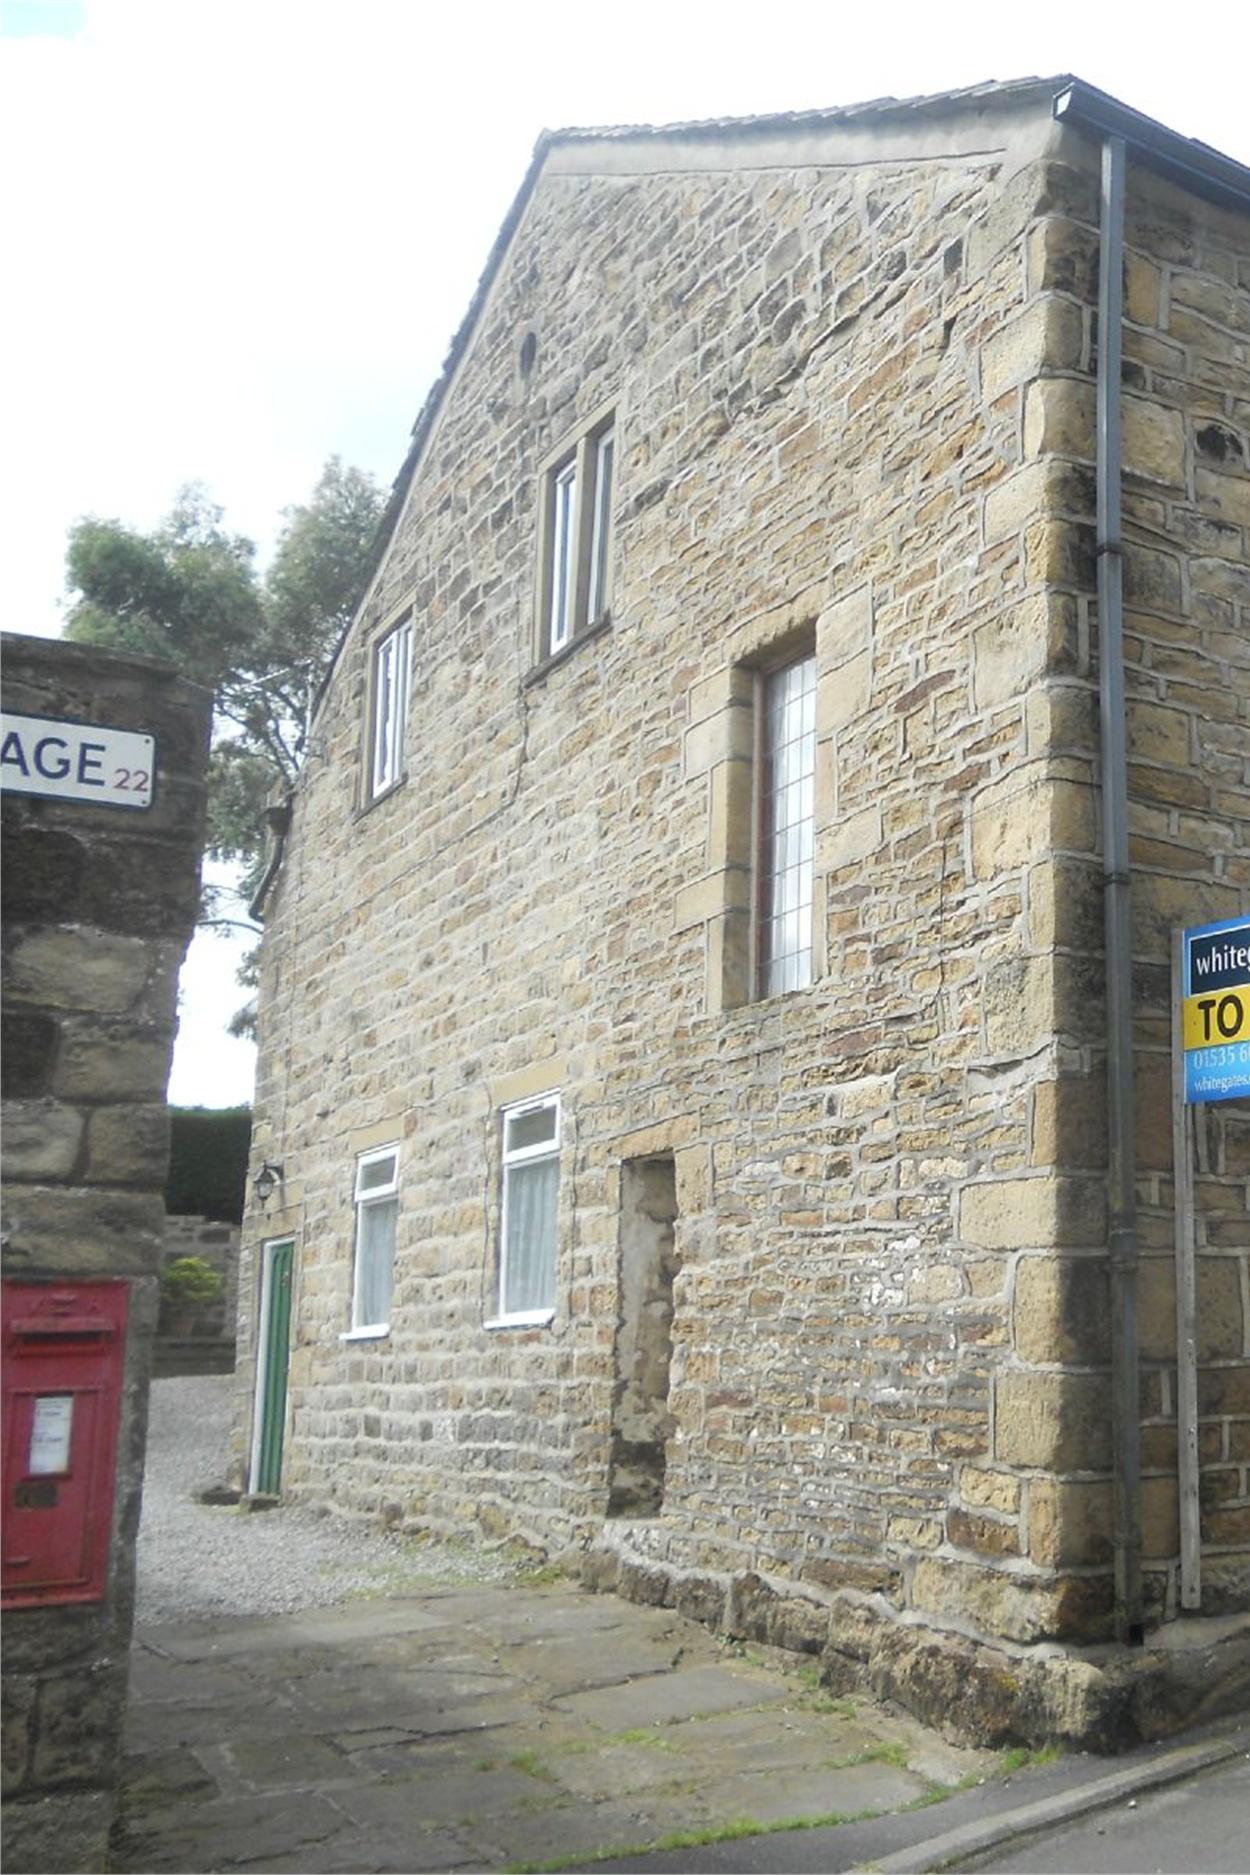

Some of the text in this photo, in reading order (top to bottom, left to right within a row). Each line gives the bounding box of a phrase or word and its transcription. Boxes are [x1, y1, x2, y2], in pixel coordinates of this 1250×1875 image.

[0, 731, 149, 792] AGE 22
[1198, 995, 1243, 1040] TO
[1194, 1047, 1235, 1070] 01535
